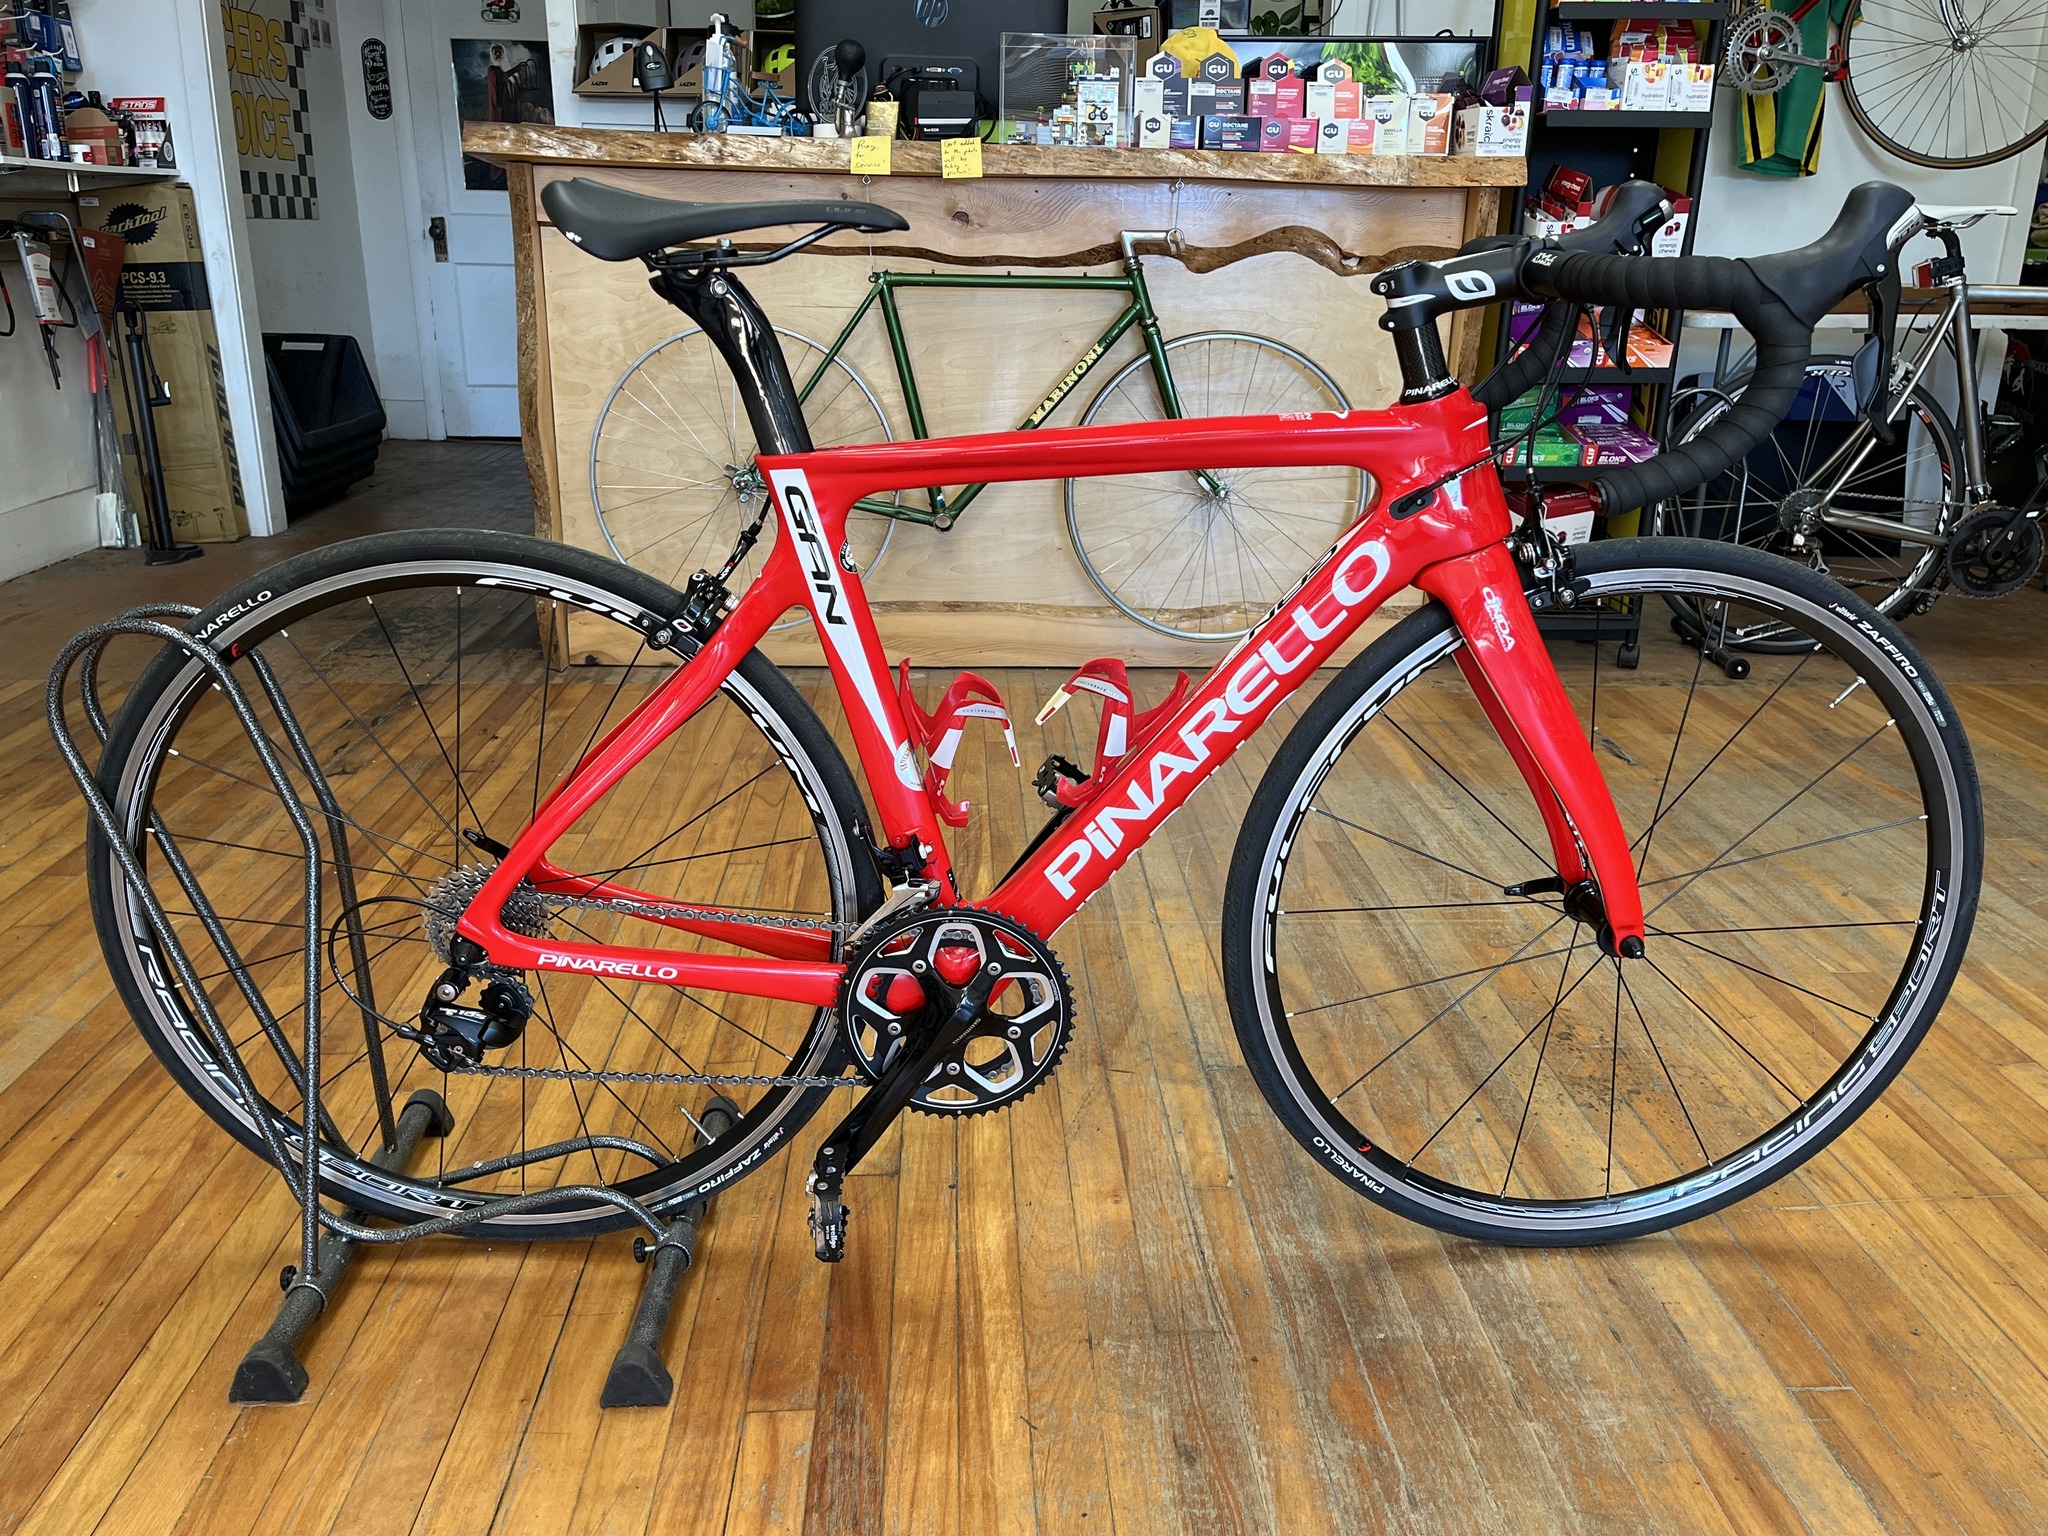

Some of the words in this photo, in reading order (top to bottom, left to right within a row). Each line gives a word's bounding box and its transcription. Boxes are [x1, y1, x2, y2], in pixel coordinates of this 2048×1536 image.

[1154, 64, 1173, 74] GU
[1208, 65, 1227, 74] GU
[1268, 65, 1287, 74] GU
[1326, 70, 1344, 78] GU
[1266, 126, 1280, 134] GU
[1324, 127, 1338, 135] GU
[1483, 109, 1495, 143] skratc
[121, 271, 166, 284] PCS-9.3
[1030, 343, 1104, 425] MARINONI
[1580, 396, 1600, 404] BLOKS
[1586, 448, 1596, 465] CLIF
[1598, 456, 1627, 464] BLOKS
[784, 485, 848, 626] GAN
[196, 590, 272, 640] NARELLO
[1857, 620, 1919, 678] ZAFFIRO
[698, 1148, 762, 1193] ZAFFIRO
[1312, 1136, 1386, 1194] PINARELLO
